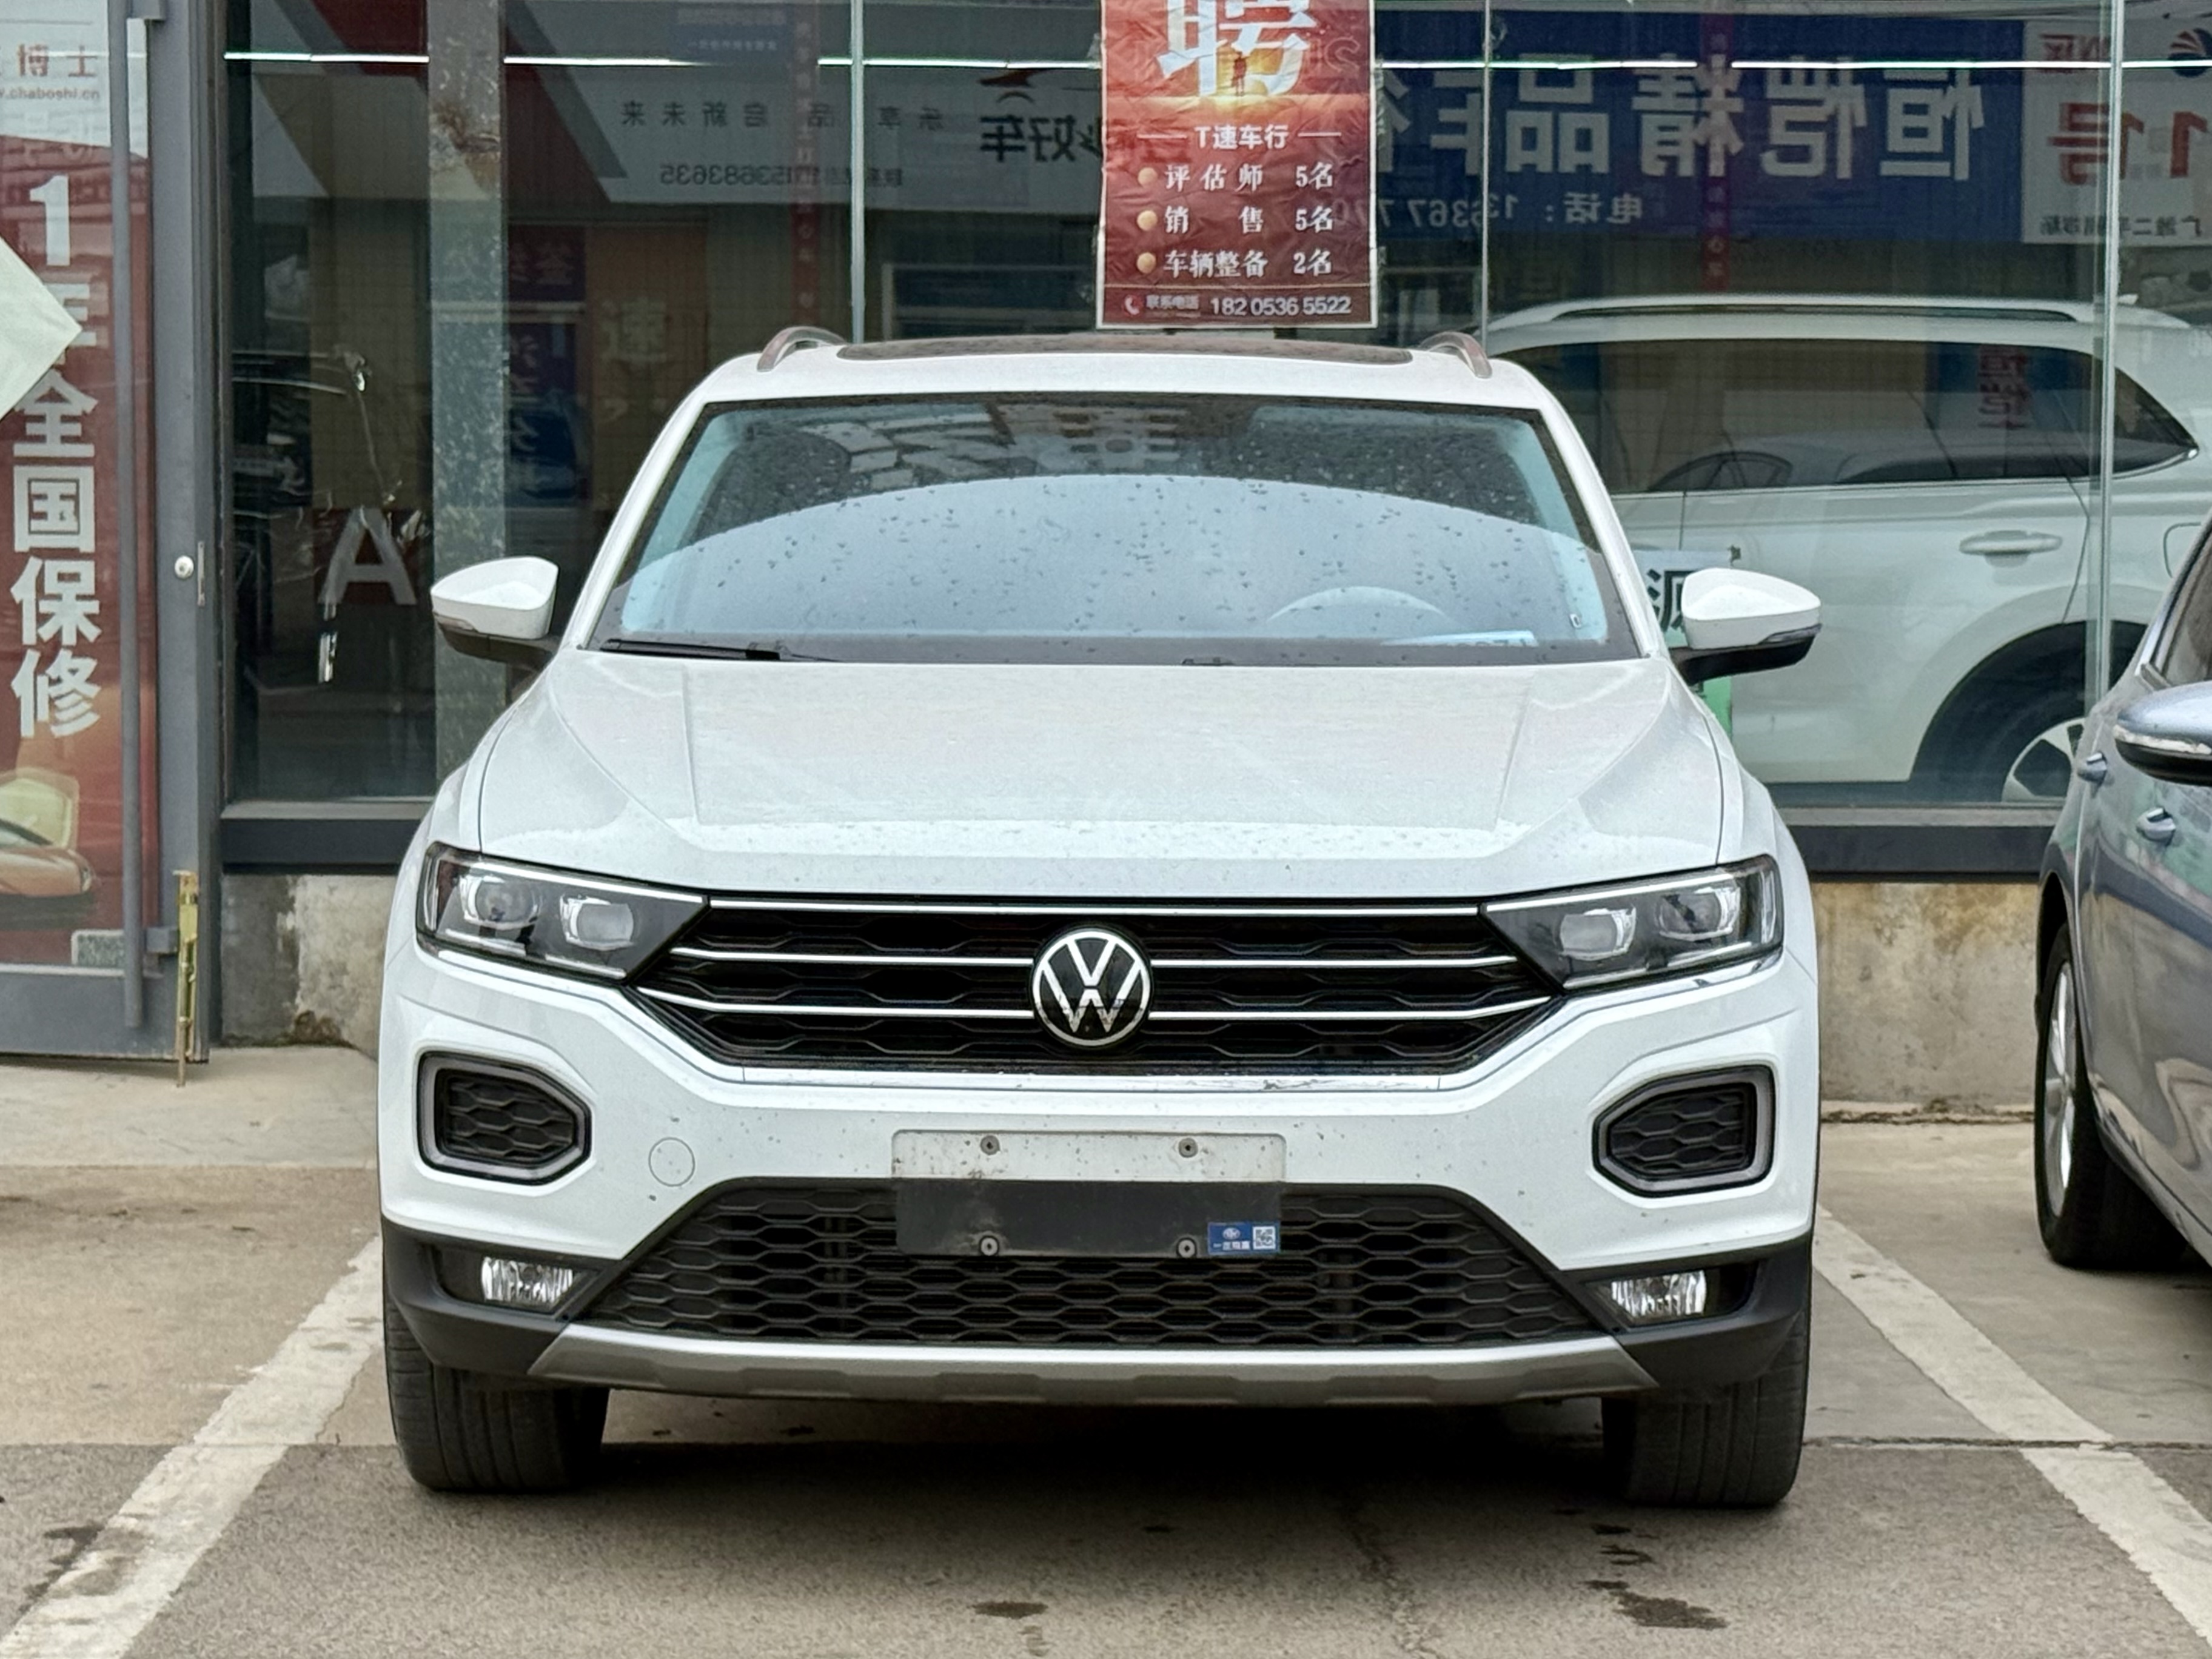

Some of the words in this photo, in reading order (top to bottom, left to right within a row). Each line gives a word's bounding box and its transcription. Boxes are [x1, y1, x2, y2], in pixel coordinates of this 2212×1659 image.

[1195, 124, 1290, 150] T速车行
[1165, 163, 1264, 192] 评估师
[1295, 162, 1333, 190] 5名
[1164, 206, 1264, 235] 销售
[1295, 206, 1334, 233] 5名
[1163, 249, 1269, 278] 车辆整备
[1293, 248, 1332, 276] 2名
[1211, 297, 1247, 316] 182
[1250, 297, 1299, 316] 0536
[1303, 295, 1352, 315] 5522
